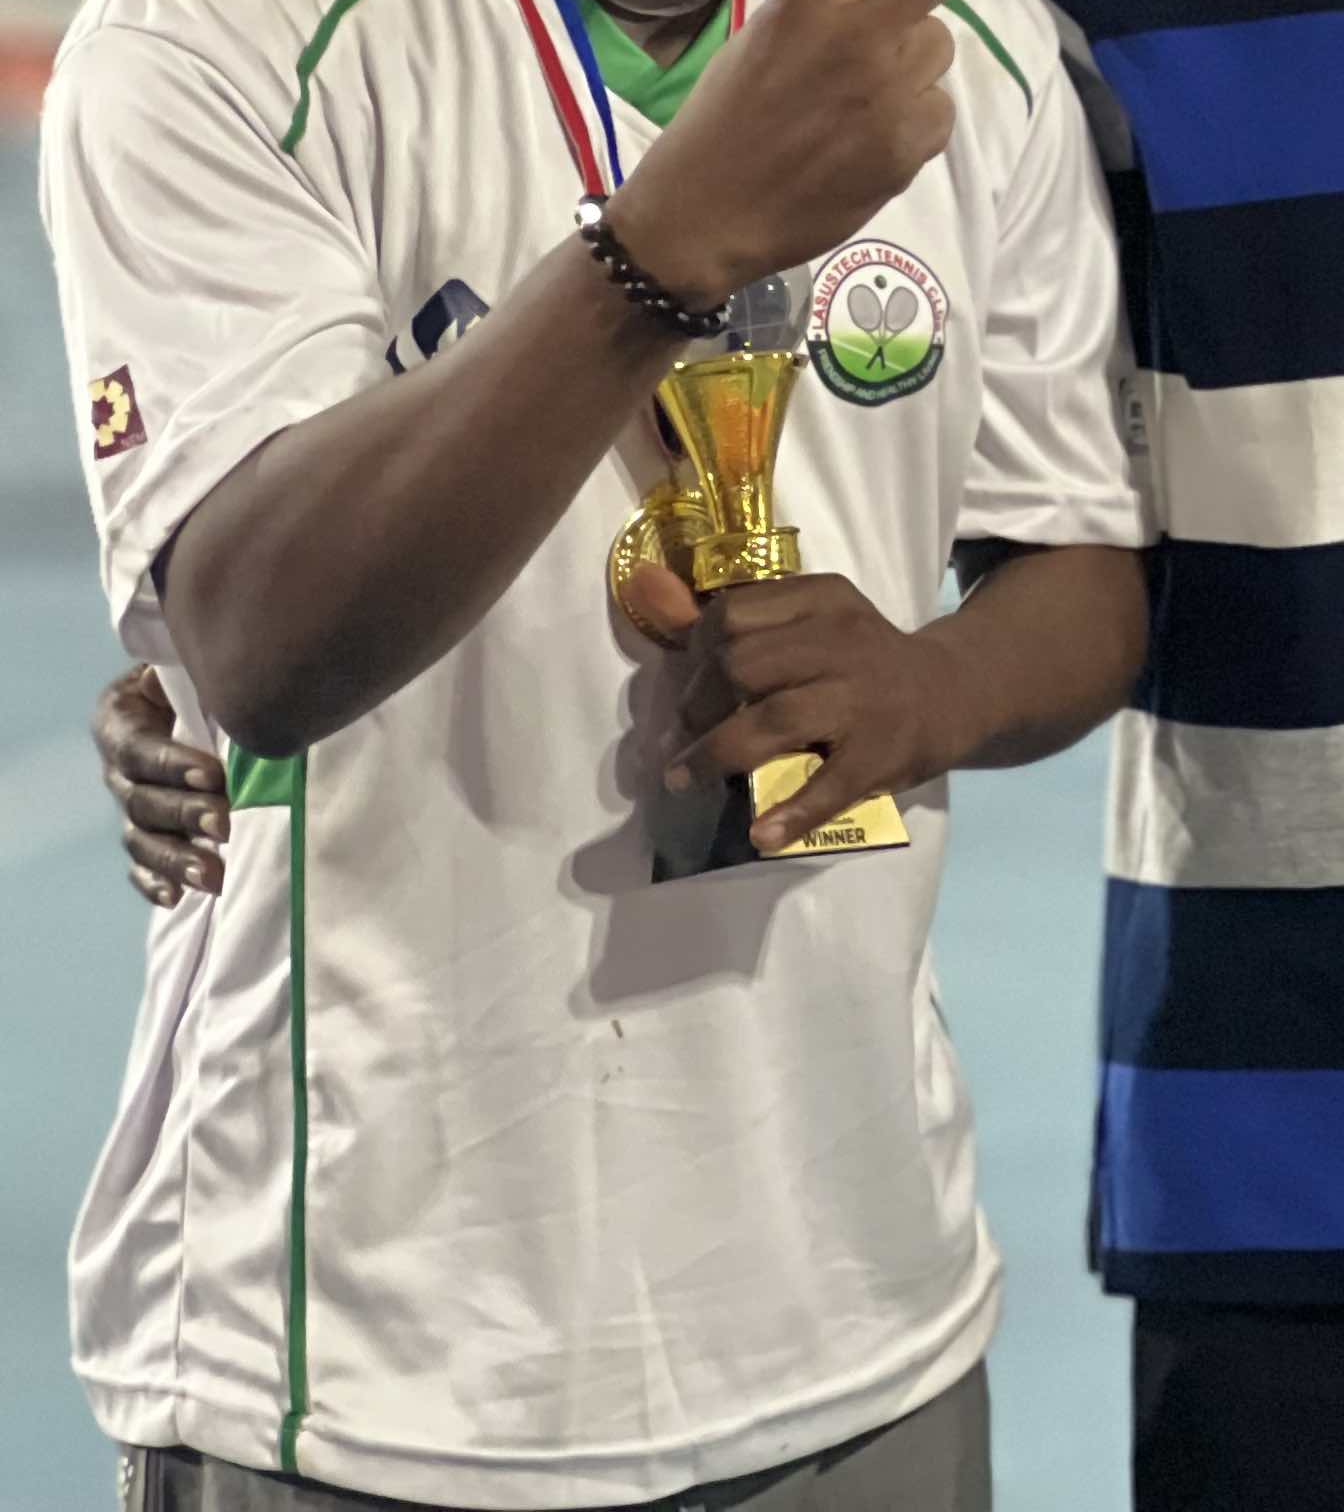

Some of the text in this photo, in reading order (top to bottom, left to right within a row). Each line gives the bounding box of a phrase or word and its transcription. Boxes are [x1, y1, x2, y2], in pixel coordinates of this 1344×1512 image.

[812, 248, 872, 331] LASUSTECH
[875, 248, 928, 285] TENNIS
[802, 827, 866, 848] WINNER
